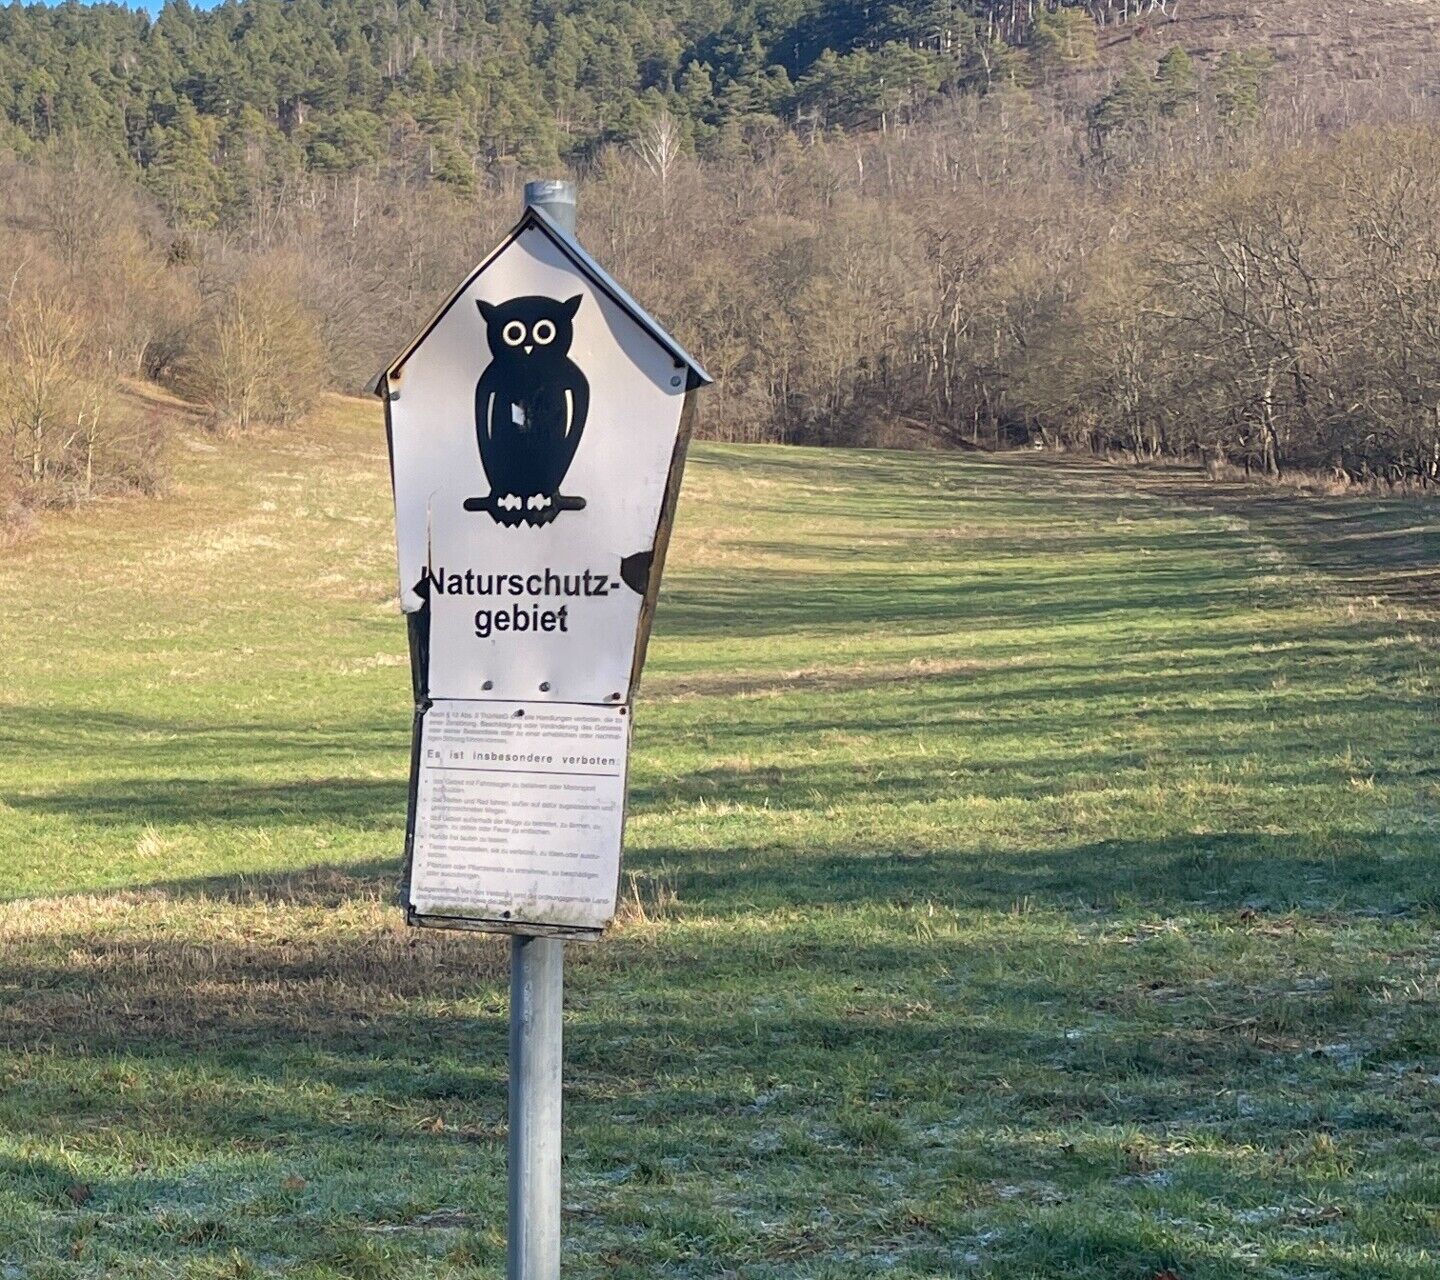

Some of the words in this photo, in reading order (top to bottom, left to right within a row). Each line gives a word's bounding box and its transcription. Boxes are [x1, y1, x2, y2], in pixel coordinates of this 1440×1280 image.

[474, 603, 569, 638] gebiet
[427, 749, 440, 759] Es
[449, 750, 465, 760] ist
[472, 751, 553, 764] insbesondere
